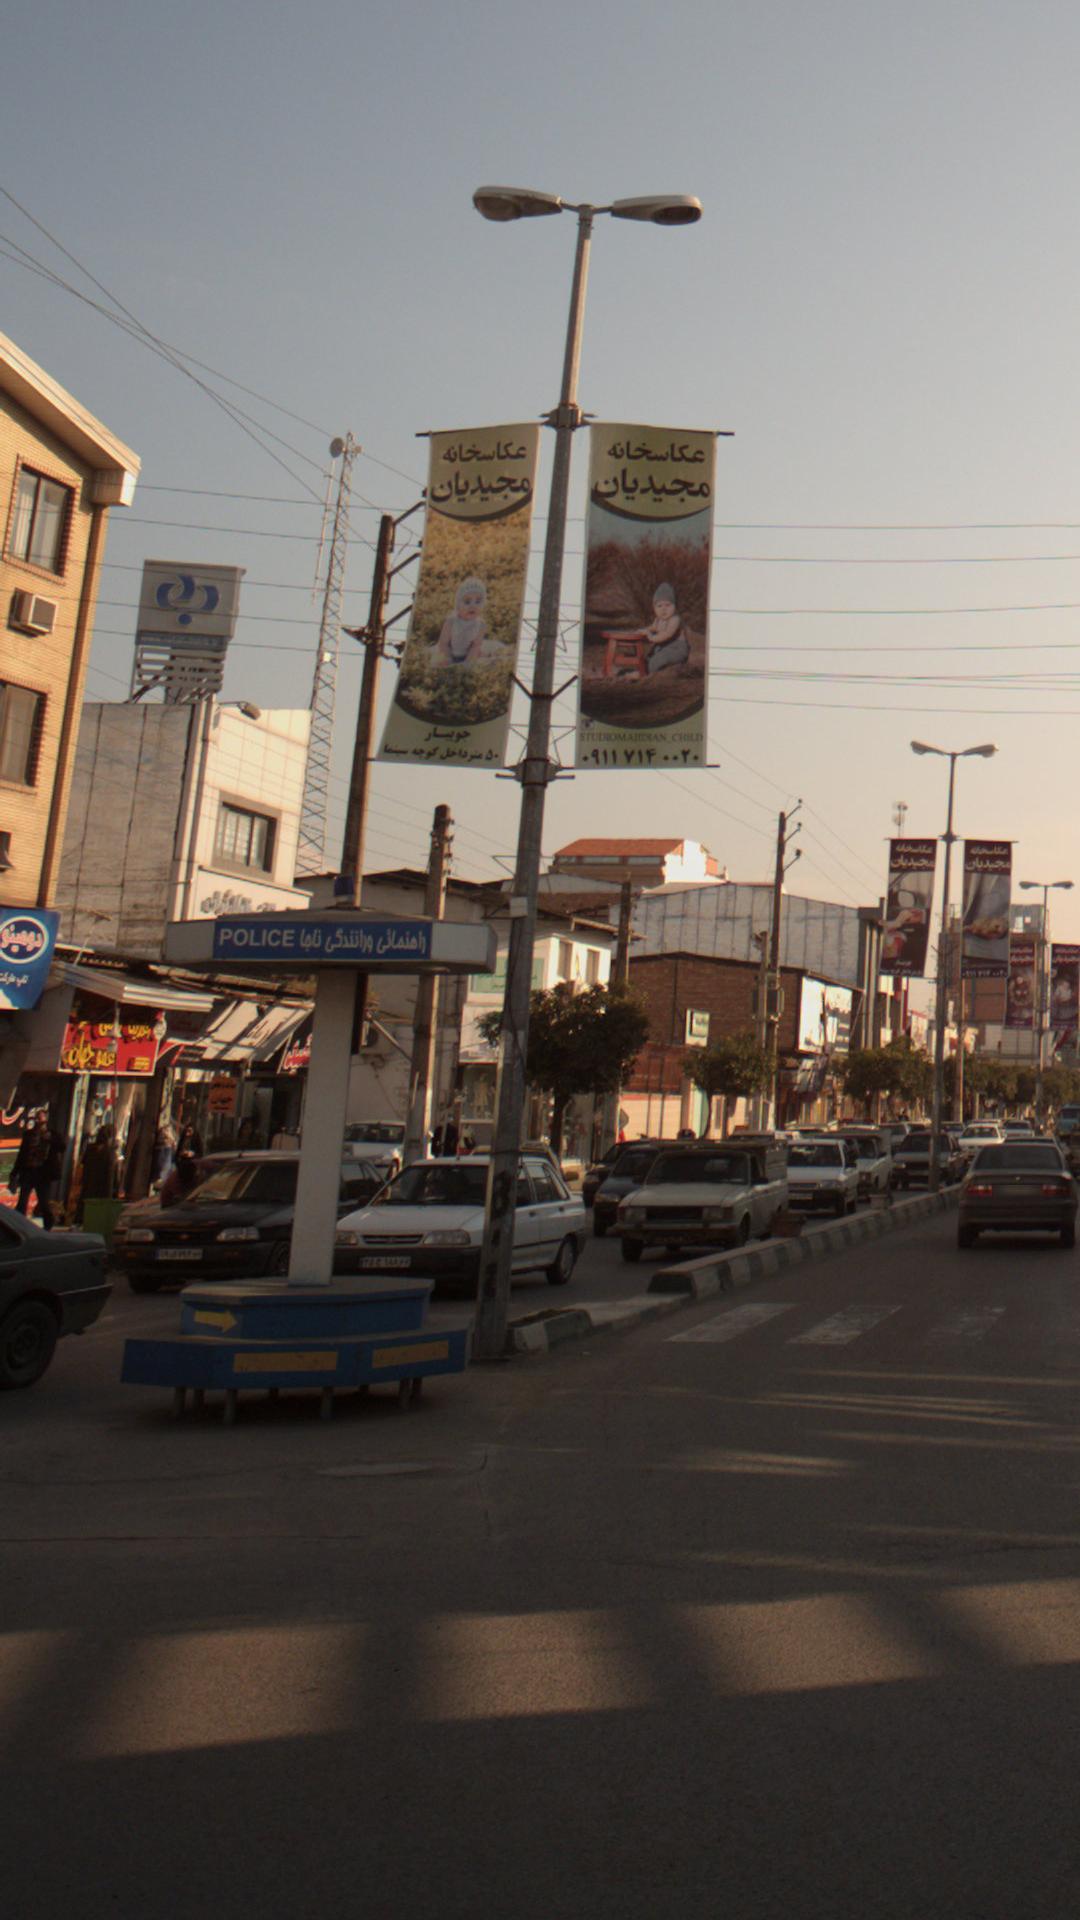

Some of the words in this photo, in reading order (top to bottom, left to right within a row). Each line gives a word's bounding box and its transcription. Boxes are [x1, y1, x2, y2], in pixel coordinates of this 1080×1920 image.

[443, 442, 527, 463] عکاسخانه
[608, 441, 705, 464] عکاسخانه
[431, 471, 530, 502] مجیدیان
[594, 468, 711, 503] مجیدیان
[582, 748, 617, 765] ۰۹۱۱
[624, 748, 657, 765] ۷۱۴
[219, 929, 295, 946] POLICE
[300, 928, 321, 952] ناجا
